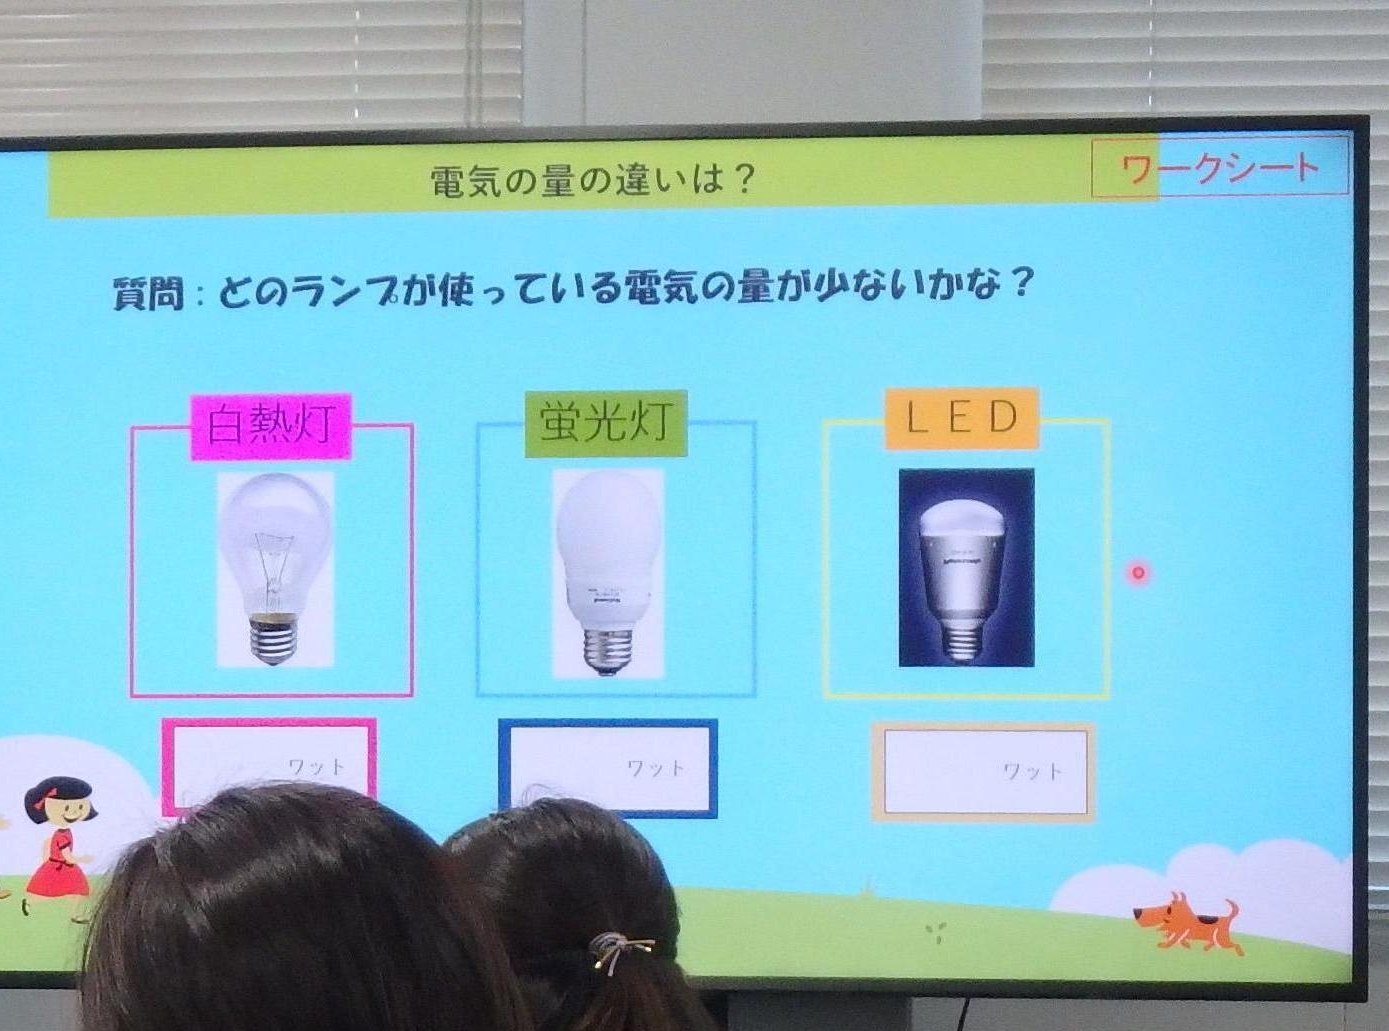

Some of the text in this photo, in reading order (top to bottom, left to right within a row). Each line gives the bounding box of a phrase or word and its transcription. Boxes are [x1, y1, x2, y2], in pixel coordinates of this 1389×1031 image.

[430, 162, 756, 199] 電気の量の違いは？
[1123, 152, 1319, 184] ワークシート
[208, 401, 337, 445] 白熱灯
[540, 399, 675, 443] 蛍光灯
[907, 399, 1018, 433] LED
[289, 758, 344, 776] ワット
[628, 759, 684, 777] ワット
[1004, 762, 1062, 781] ワット
